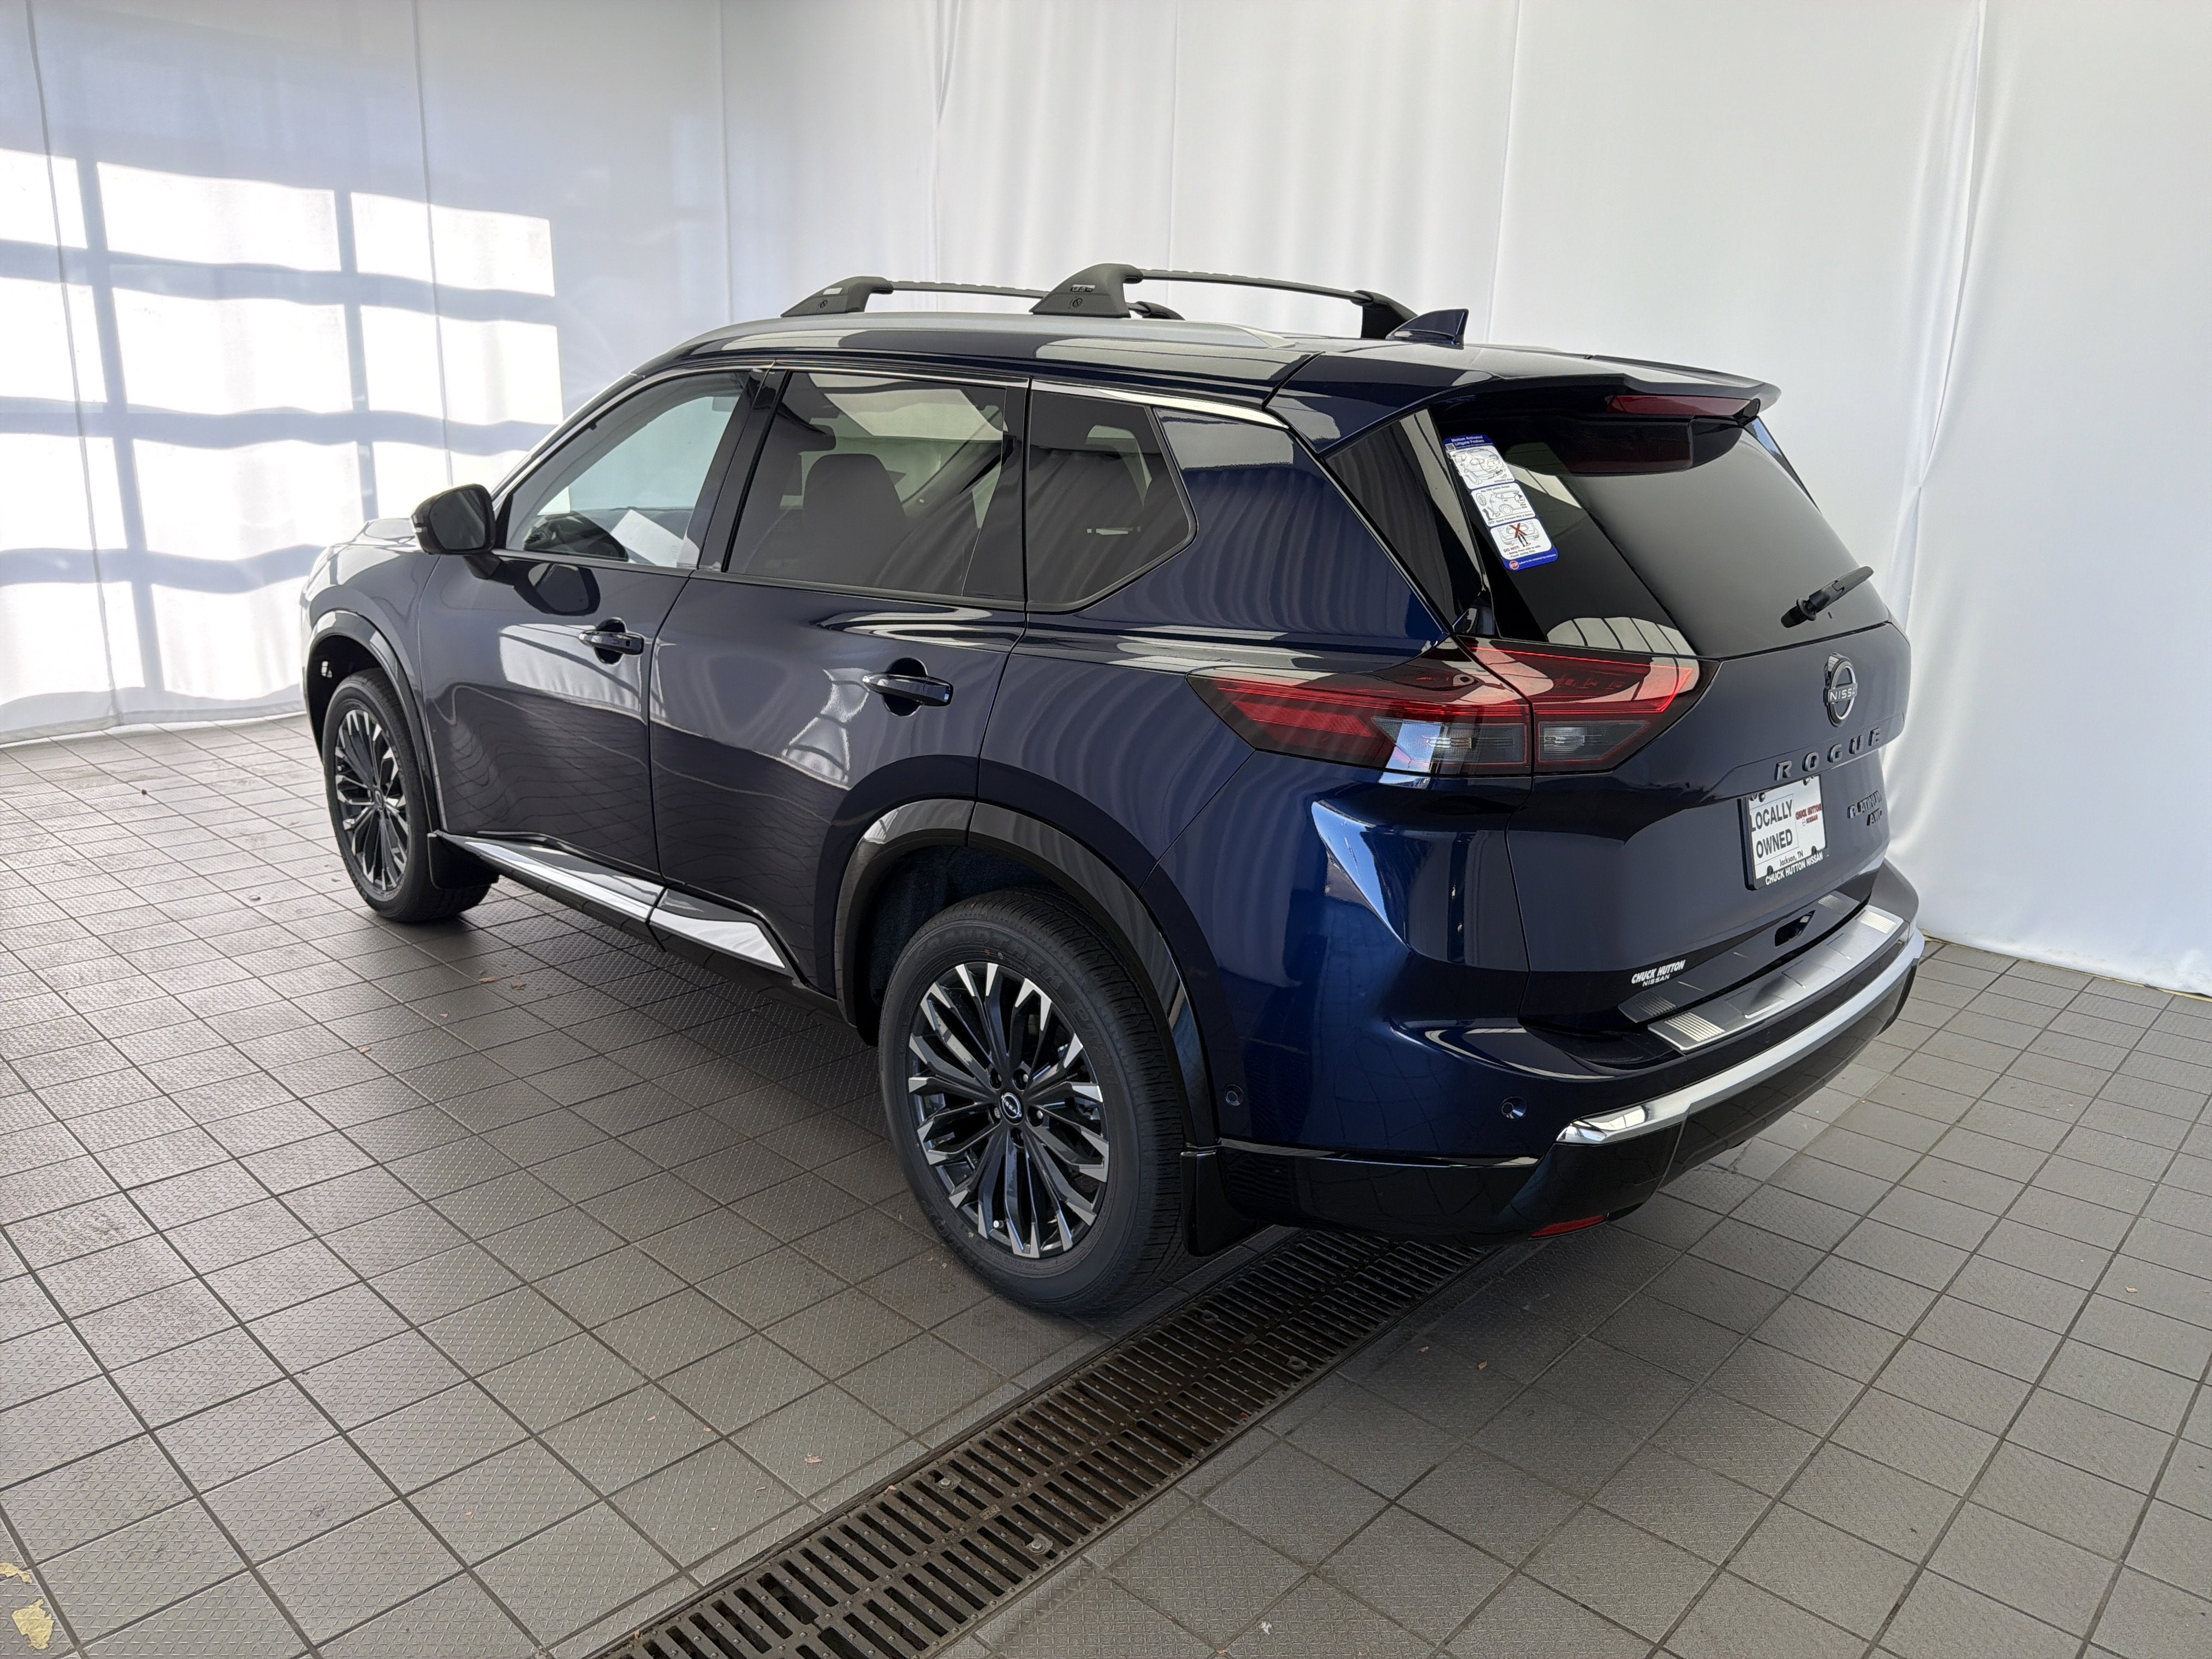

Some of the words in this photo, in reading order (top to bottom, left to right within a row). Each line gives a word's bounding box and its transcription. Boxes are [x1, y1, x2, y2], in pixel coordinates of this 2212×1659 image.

[1774, 727, 1881, 781] ROGUE
[1750, 799, 1792, 832] LOCALLY
[1796, 809, 1807, 820] CHUCK
[1807, 803, 1822, 815] HUTTON
[1756, 829, 1792, 859] OWNED
[1765, 870, 1785, 885] CHUCK
[1785, 862, 1805, 877] HUTTON
[1806, 851, 1823, 866] NISSAN
[1780, 856, 1797, 867] Jackson,
[1631, 968, 1657, 984] CHUCK
[1657, 960, 1686, 977] HUTTON
[1642, 974, 1671, 987] NISSAN
